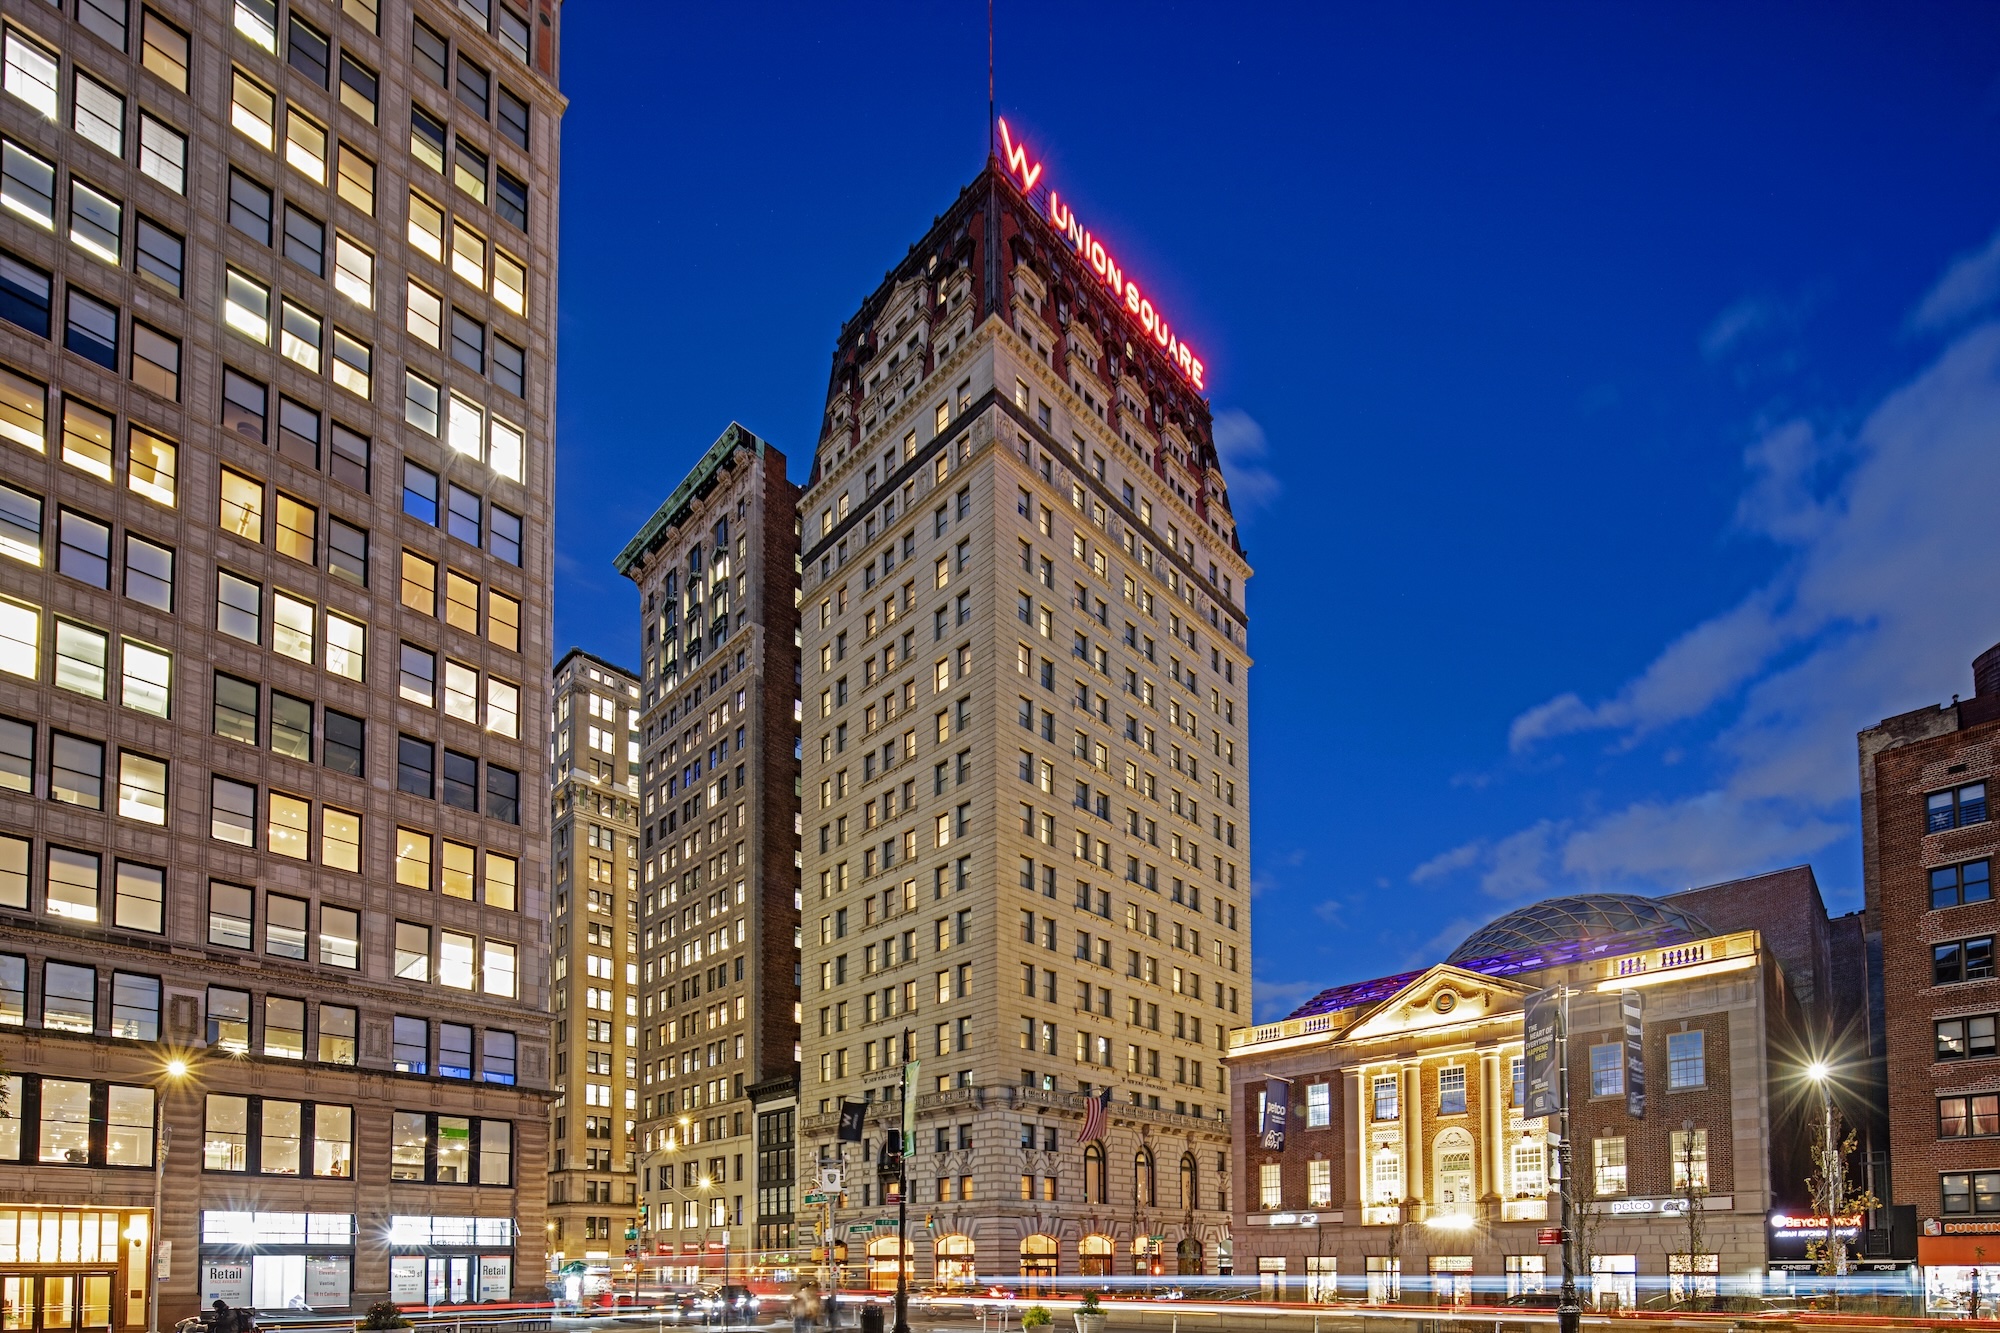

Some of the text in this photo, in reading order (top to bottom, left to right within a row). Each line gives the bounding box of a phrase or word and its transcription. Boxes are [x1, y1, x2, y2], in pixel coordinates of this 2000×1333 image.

[998, 115, 1204, 390] W UNION SQUARE
[1528, 1024, 1538, 1033] THE
[1530, 1026, 1553, 1040] HEART OF
[1526, 1034, 1554, 1050] EVERYTHING
[1526, 1043, 1549, 1057] HAPPENS
[1535, 1052, 1548, 1062] HERE
[1266, 1102, 1286, 1116] petco
[1613, 1201, 1651, 1213] petco
[1833, 1214, 1862, 1227] WOK
[1944, 1222, 2000, 1233] DUNKIN
[210, 1267, 242, 1280] Retail
[482, 1265, 506, 1276] Retail
[1873, 1263, 1897, 1271] POKÉ
